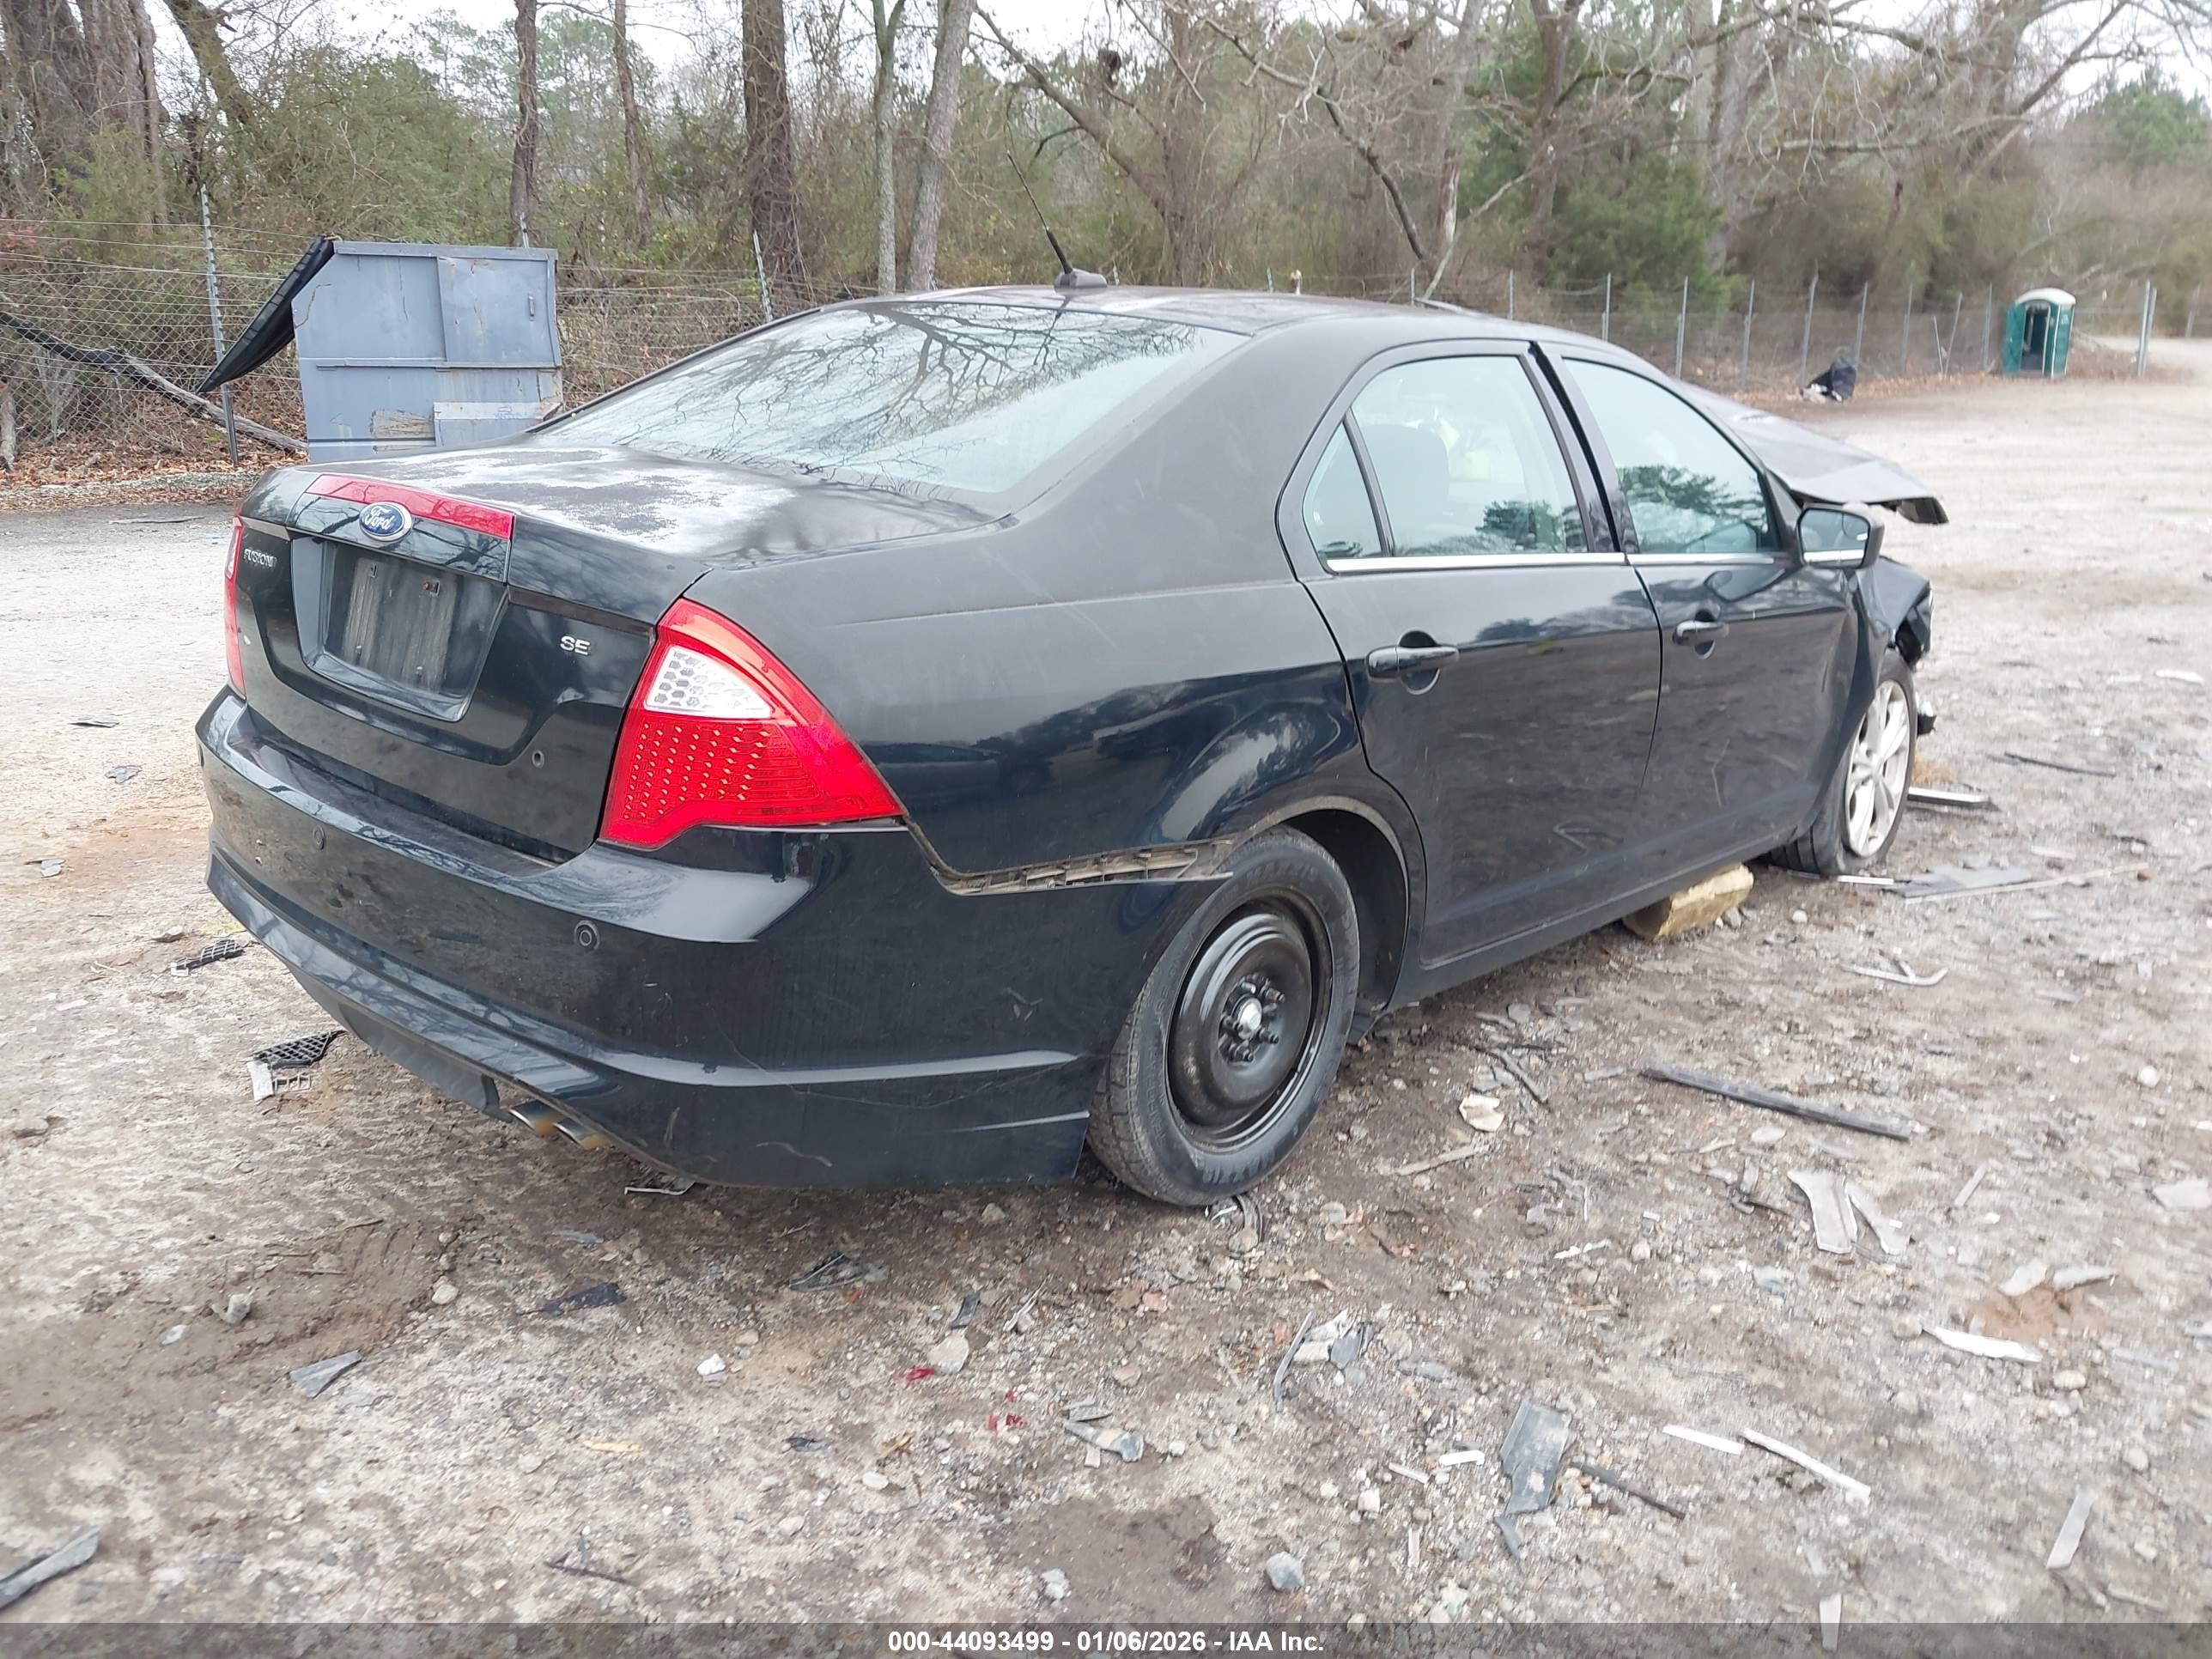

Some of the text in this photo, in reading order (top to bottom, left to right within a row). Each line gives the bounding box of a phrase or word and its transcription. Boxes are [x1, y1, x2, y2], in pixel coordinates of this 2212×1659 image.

[365, 505, 395, 530] Ford
[244, 548, 276, 568] FUSION
[560, 635, 591, 655] SE
